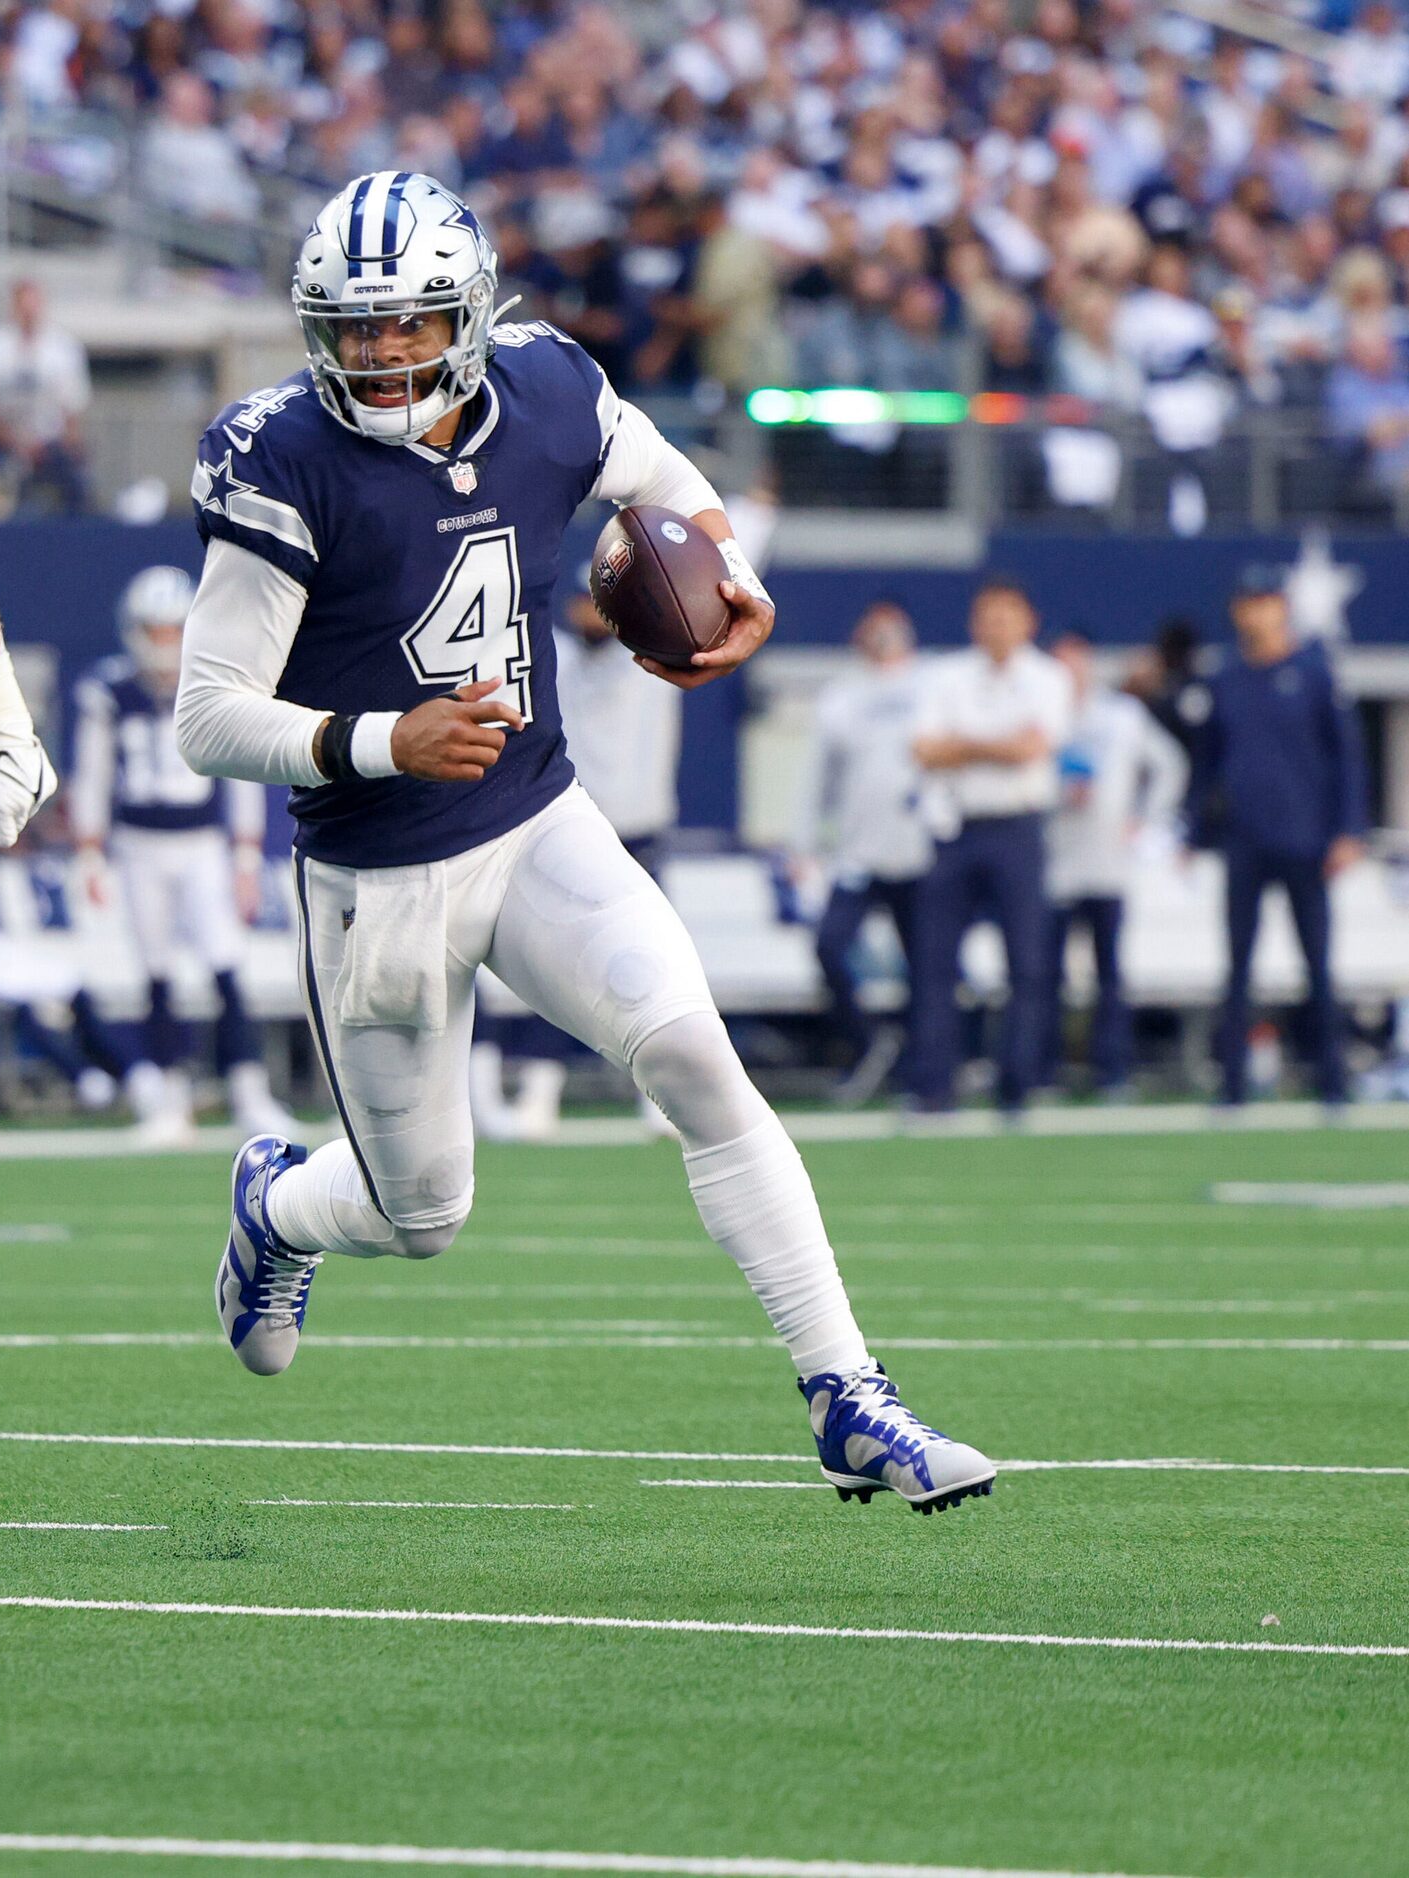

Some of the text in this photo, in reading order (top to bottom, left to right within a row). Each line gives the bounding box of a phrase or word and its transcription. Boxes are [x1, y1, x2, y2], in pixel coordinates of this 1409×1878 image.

[354, 285, 395, 294] COWBOYS
[230, 384, 309, 433] 4
[436, 507, 498, 533] COWBOYS
[400, 525, 534, 729] 4
